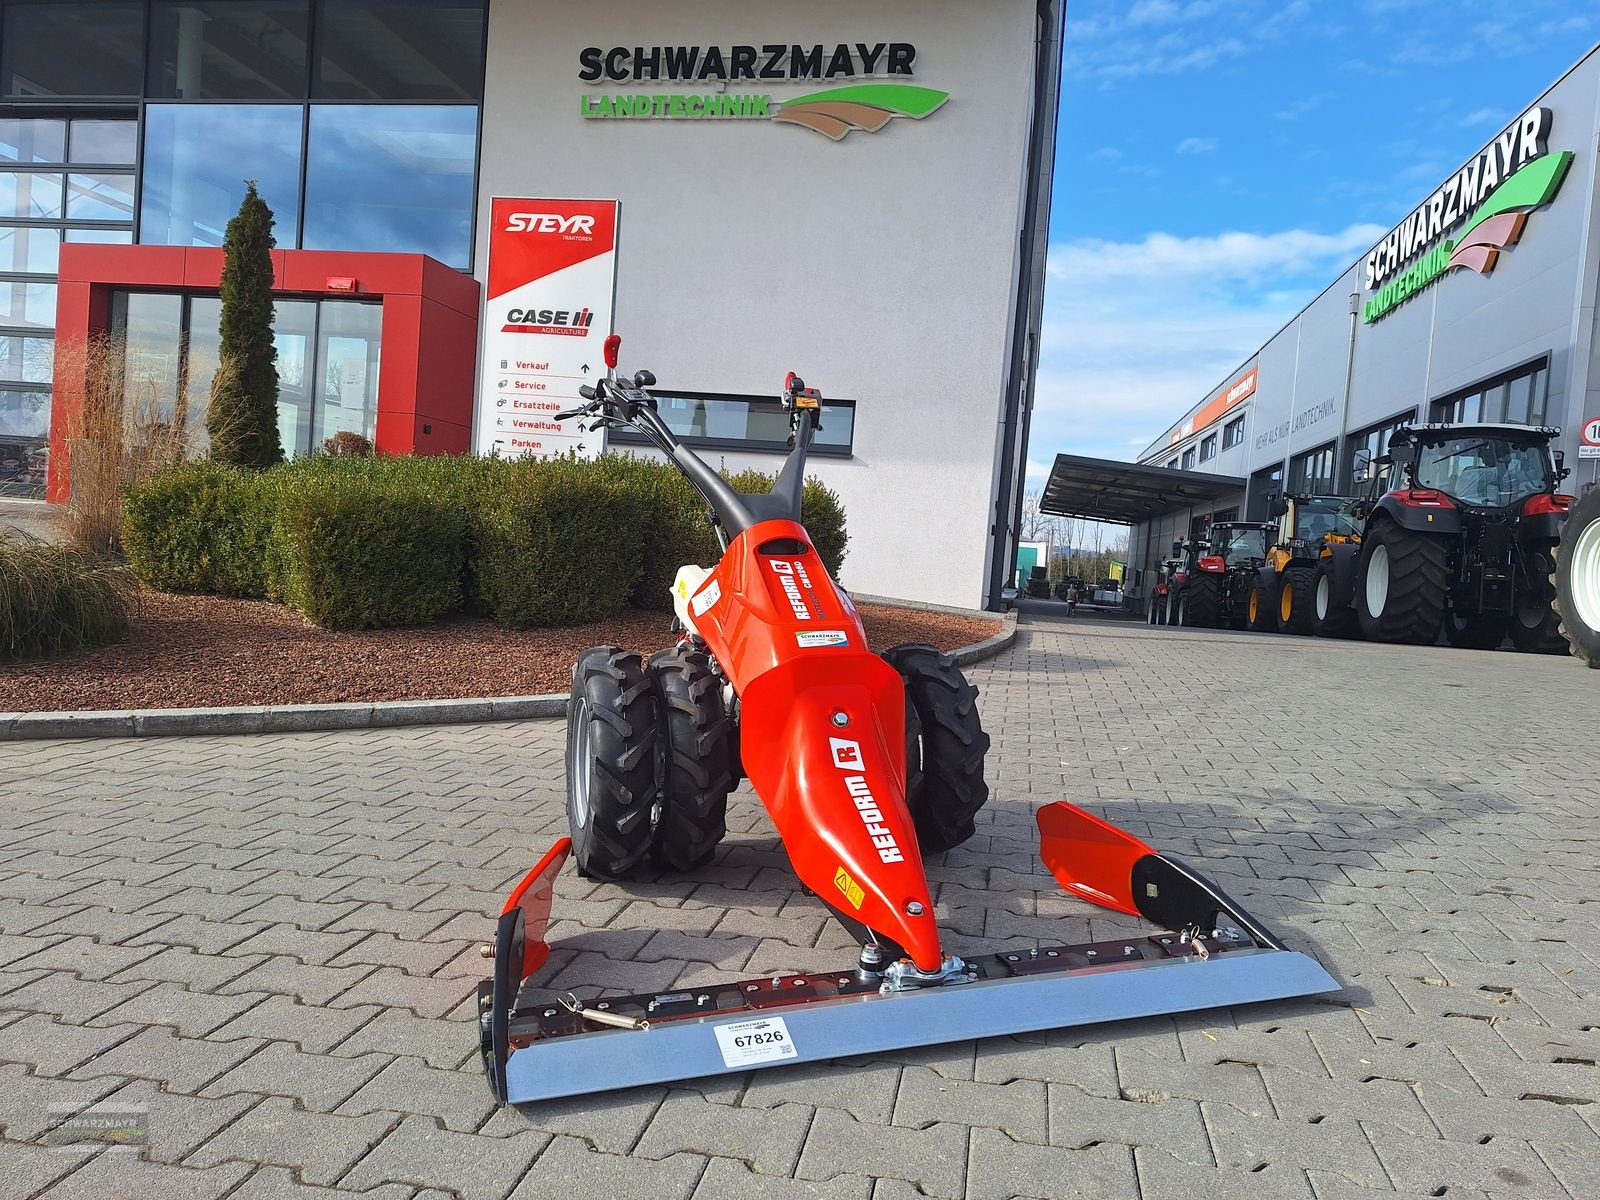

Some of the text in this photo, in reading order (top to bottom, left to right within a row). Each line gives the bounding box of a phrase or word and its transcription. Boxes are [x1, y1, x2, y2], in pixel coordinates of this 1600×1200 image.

[578, 43, 917, 81] SCHWARZMAYR
[580, 94, 771, 119] LANDTECHNIK
[1365, 107, 1546, 290] SCHWARZMAYR
[504, 212, 596, 235] STEYR
[1363, 240, 1453, 324] LANDTECHNIK
[507, 308, 569, 325] CASE
[541, 327, 587, 336] AGRICULTURE
[516, 361, 550, 371] Verkauf
[514, 381, 547, 391] Service
[513, 400, 561, 411] Ersatzteile
[512, 420, 562, 432] Verwaltung
[511, 439, 542, 449] Parken
[779, 575, 811, 620] REFORM
[844, 775, 905, 864] REFORM
[734, 1031, 784, 1048] 67826
